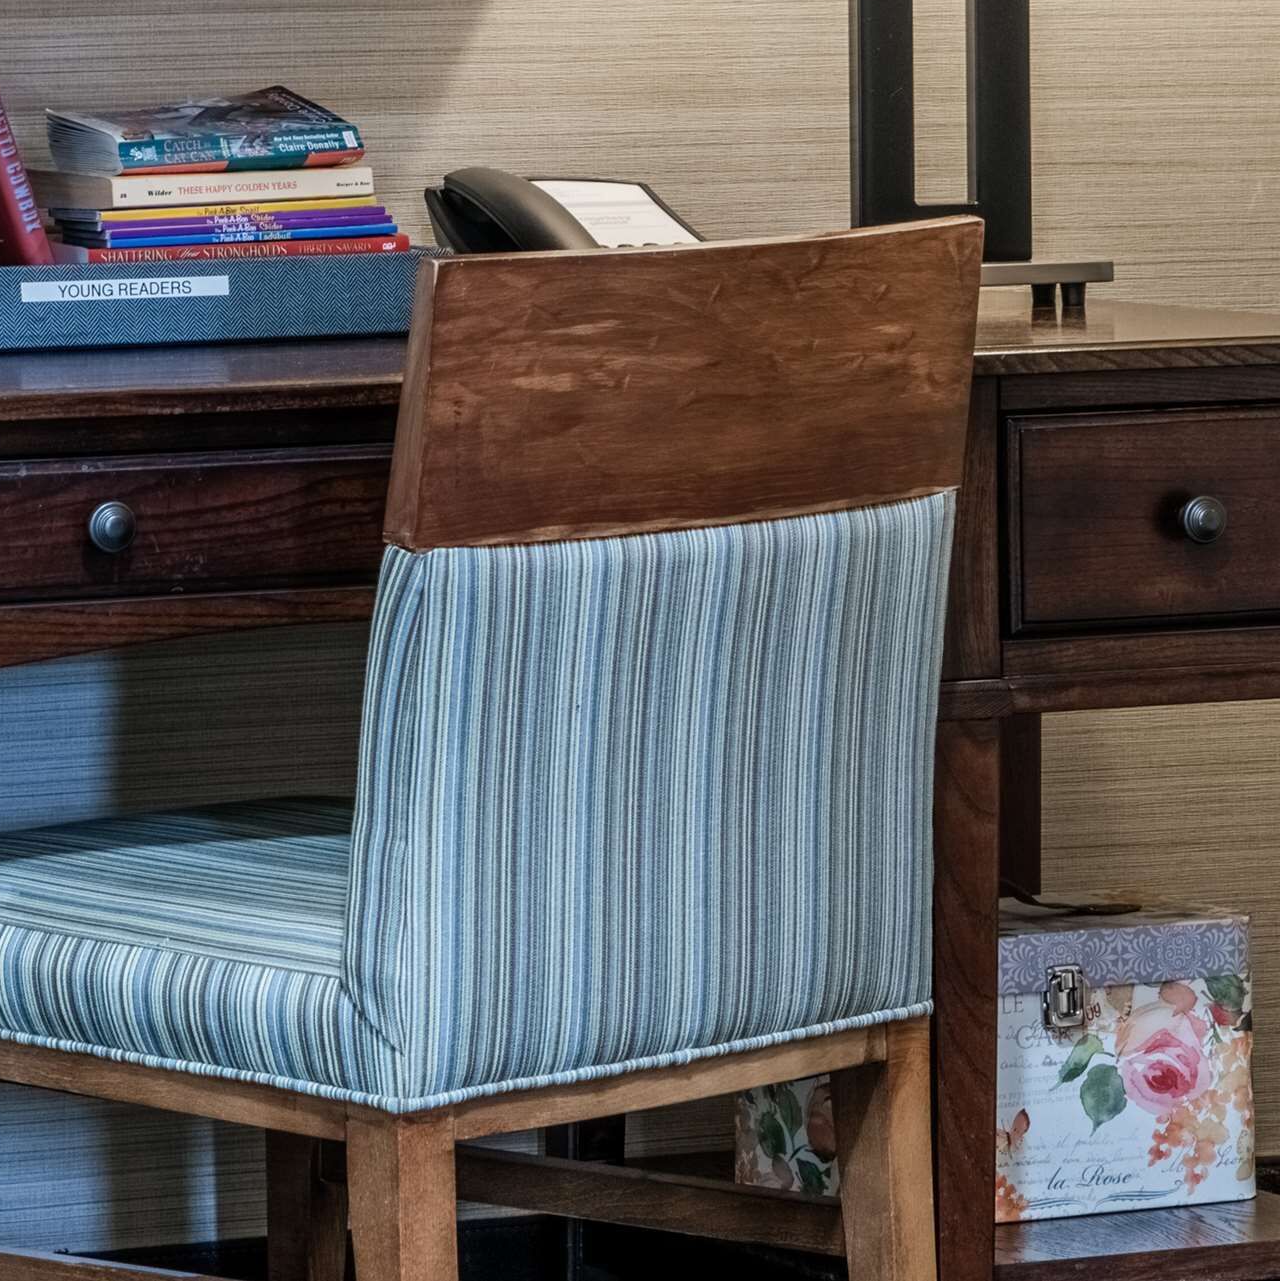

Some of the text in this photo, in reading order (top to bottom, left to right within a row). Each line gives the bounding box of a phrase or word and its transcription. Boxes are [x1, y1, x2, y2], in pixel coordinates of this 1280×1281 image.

[163, 139, 201, 153] CATCH
[279, 140, 340, 152] Claire Donally
[163, 151, 217, 163] CAT CAN
[6, 160, 42, 234] COWBOY
[147, 180, 298, 197] Wilder THESE HAPPY GOLDEN YEARS
[203, 244, 288, 259] STRONGHOLDS
[298, 243, 335, 255] LIBERTY
[337, 242, 372, 252] SAVARD
[58, 279, 193, 299] YOUNG READERS
[1047, 1164, 1132, 1191] la Rose
